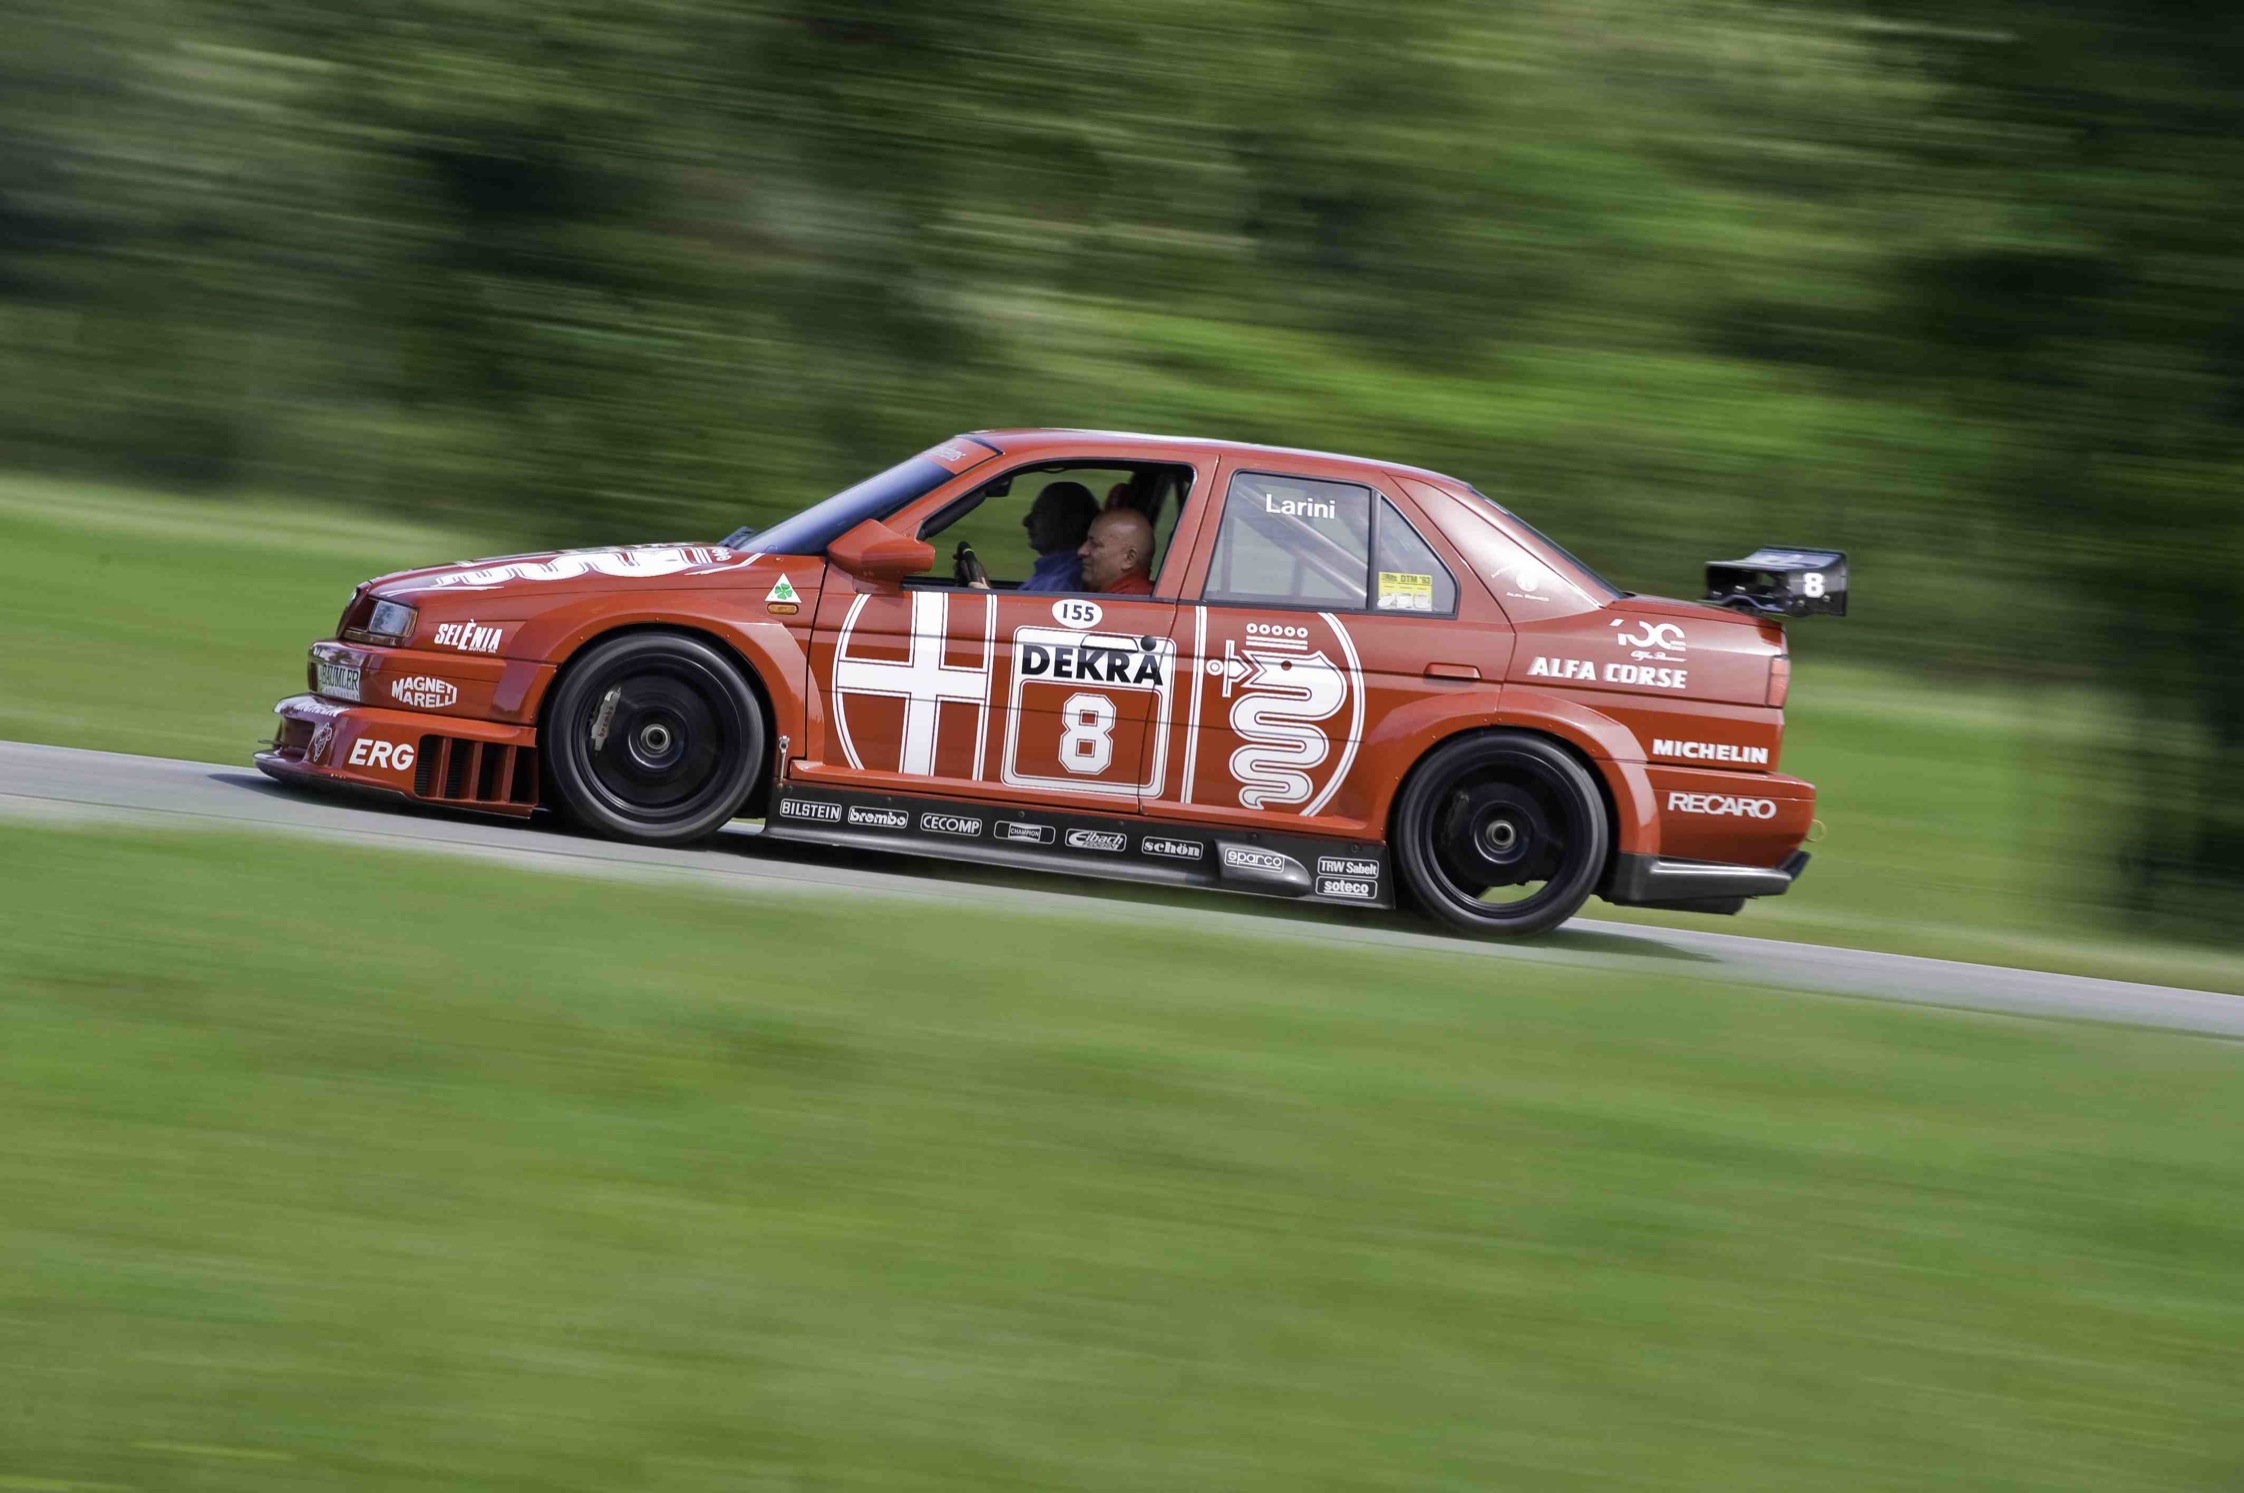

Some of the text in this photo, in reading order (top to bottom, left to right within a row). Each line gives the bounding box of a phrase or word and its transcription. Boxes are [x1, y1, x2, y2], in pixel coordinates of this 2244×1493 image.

[1265, 494, 1336, 519] Larini
[1803, 573, 1825, 598] 8
[1063, 603, 1095, 622] 155
[1021, 645, 1163, 686] DEKRA
[1526, 656, 1688, 689] ALFA CORSE
[1058, 692, 1117, 775] 8
[348, 738, 415, 771] ERG
[1652, 738, 1769, 764] MICHELIN
[781, 801, 841, 819] BILSTEIN
[1667, 792, 1777, 819] RECARO
[850, 808, 906, 826] brembo
[923, 815, 980, 834] CECOMP
[1010, 826, 1040, 838] CHAMPION
[1069, 831, 1124, 849] Eibach
[1144, 840, 1200, 857] schön
[1228, 851, 1282, 867] sparco
[1320, 860, 1377, 875] TRW Sabelt
[1324, 880, 1370, 893] soteco
